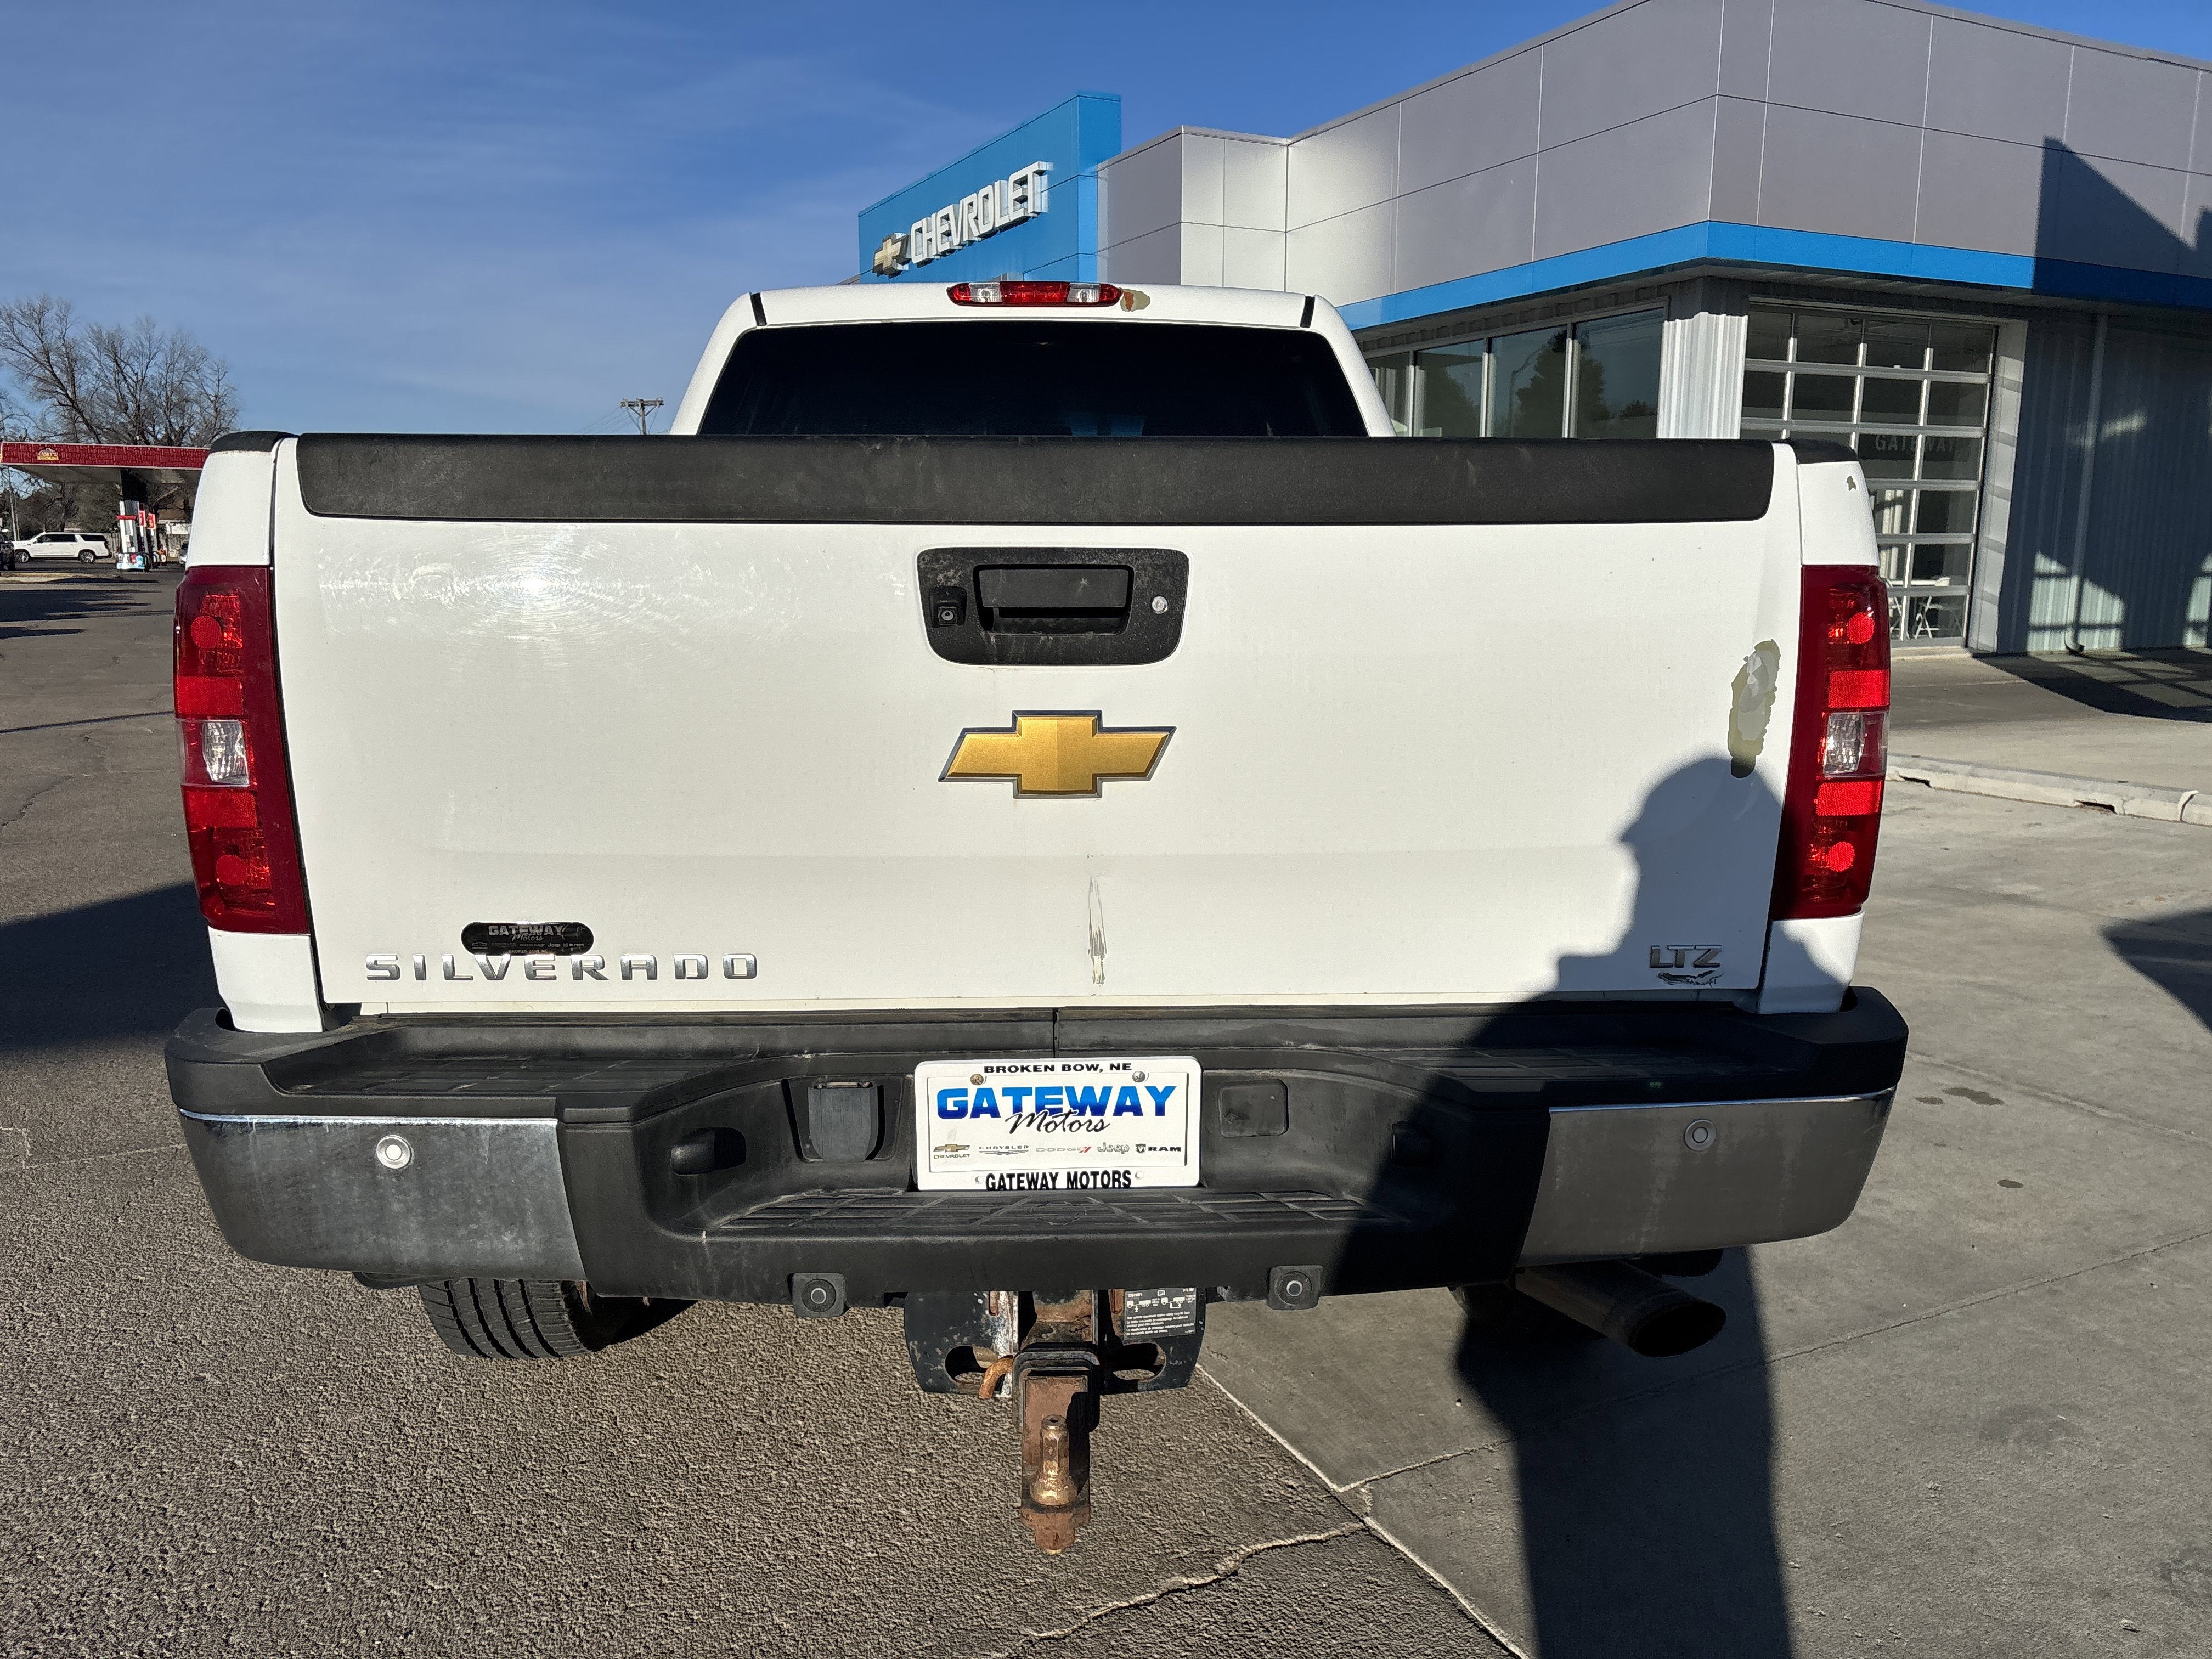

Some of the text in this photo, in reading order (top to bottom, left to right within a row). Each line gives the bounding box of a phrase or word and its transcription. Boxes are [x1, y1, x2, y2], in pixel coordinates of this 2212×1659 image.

[911, 161, 1053, 267] CHEVROLET
[488, 925, 563, 936] GATEWAY
[511, 933, 544, 941] Motors
[366, 953, 758, 981] SILVERADO
[1650, 944, 1722, 968] LTZ
[984, 1063, 1132, 1073] BROKEN BOW, NE
[937, 1086, 1177, 1119] GATEWAY
[1005, 1109, 1111, 1135] Motors
[1097, 1142, 1130, 1154] Jeep
[985, 1169, 1132, 1191] GATEWAY MOTORS
